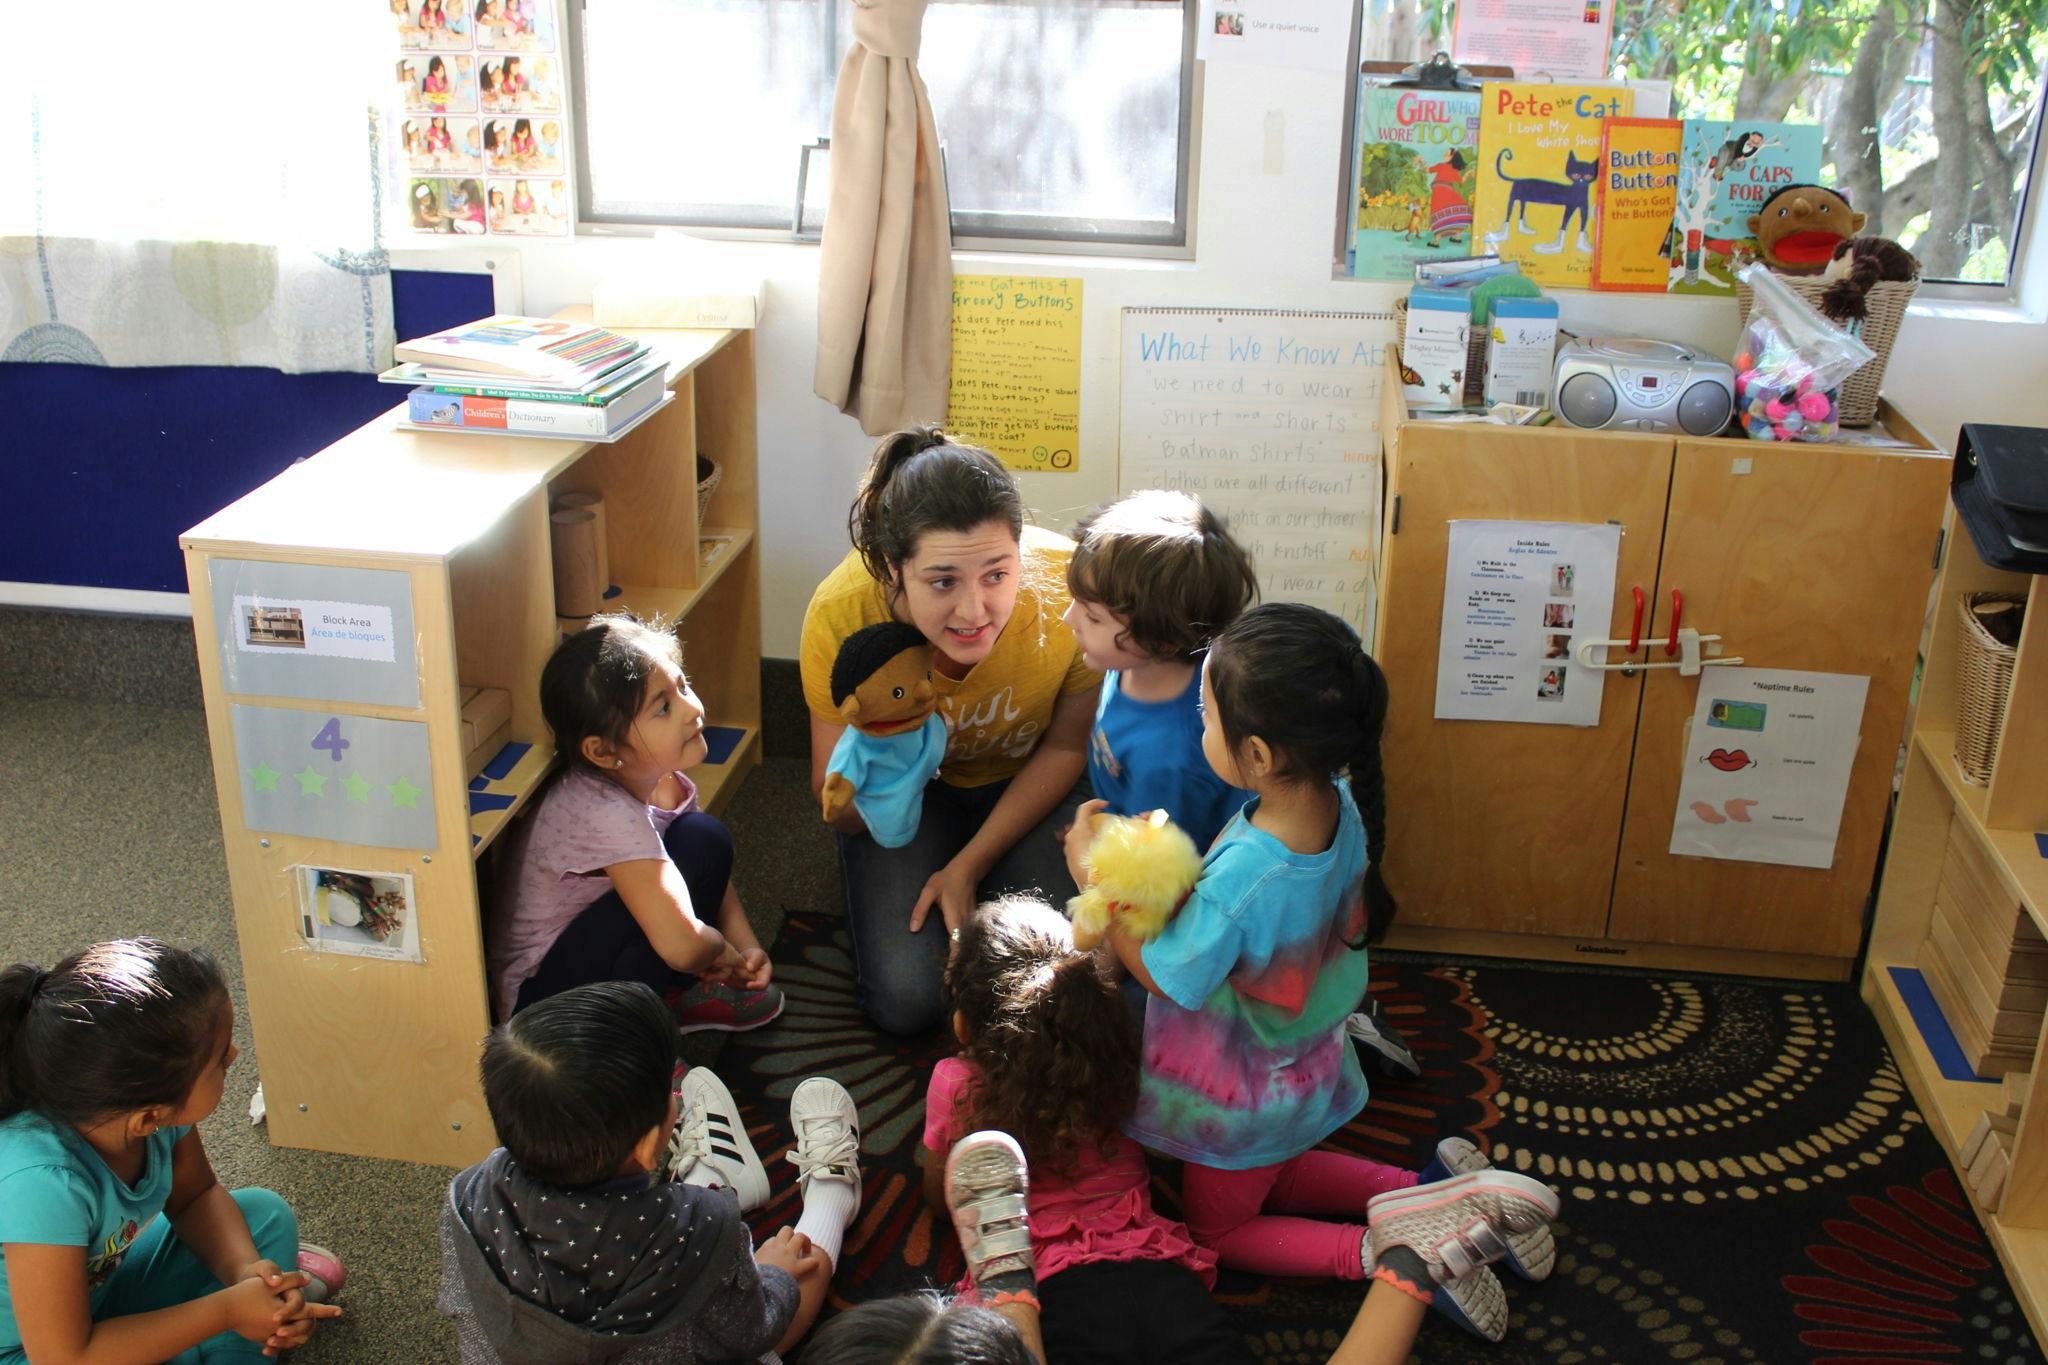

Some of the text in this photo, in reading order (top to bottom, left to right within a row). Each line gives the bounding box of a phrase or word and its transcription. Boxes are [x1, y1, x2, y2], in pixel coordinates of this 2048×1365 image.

[1252, 19, 1267, 29] Use
[1275, 22, 1296, 32] quiet
[1299, 24, 1320, 33] voice
[1447, 101, 1478, 115] WHO
[1497, 89, 1621, 118] Pete the Cat
[1378, 127, 1413, 142] WORE
[1413, 122, 1466, 145] TOO
[1508, 120, 1570, 134] I Love My
[1536, 135, 1600, 148] White Shoe
[1610, 150, 1678, 168] Button
[1750, 165, 1794, 183] CAPS
[1610, 172, 1678, 191] Button
[1729, 184, 1764, 201] FOR
[1615, 196, 1671, 207] Who's Got
[1612, 208, 1675, 219] the Button?
[991, 278, 1013, 291] Cat
[952, 291, 1074, 311] Groovy Buttons
[996, 317, 1015, 326] Pete
[1020, 318, 1041, 326] need
[1045, 319, 1064, 328] his
[982, 327, 1006, 336] for?
[1140, 332, 1386, 367] What We Know Ab
[956, 380, 1078, 396] does Pete not care about
[1192, 376, 1244, 393] need
[1261, 378, 1285, 395] to
[1303, 383, 1353, 399] wear
[971, 392, 987, 400] his
[992, 394, 1045, 403] buttons?
[464, 407, 557, 424] Children's Dictionary
[1235, 410, 1260, 420] and
[981, 420, 998, 429] Pete
[1004, 422, 1022, 432] get
[1025, 422, 1040, 430] his
[1044, 423, 1078, 432] buttons
[980, 432, 1025, 441] his coat?
[1214, 476, 1240, 489] are
[1248, 473, 1267, 490] all
[1266, 512, 1280, 525] on
[1286, 512, 1310, 525] our
[1283, 578, 1324, 593] wear
[1336, 580, 1345, 593] a
[322, 615, 372, 627] Block Area
[335, 629, 347, 639] de
[348, 630, 386, 642] bloques
[1793, 684, 1815, 694] Rules
[310, 717, 350, 762] 4
[1575, 944, 1627, 955] Lakeshore
